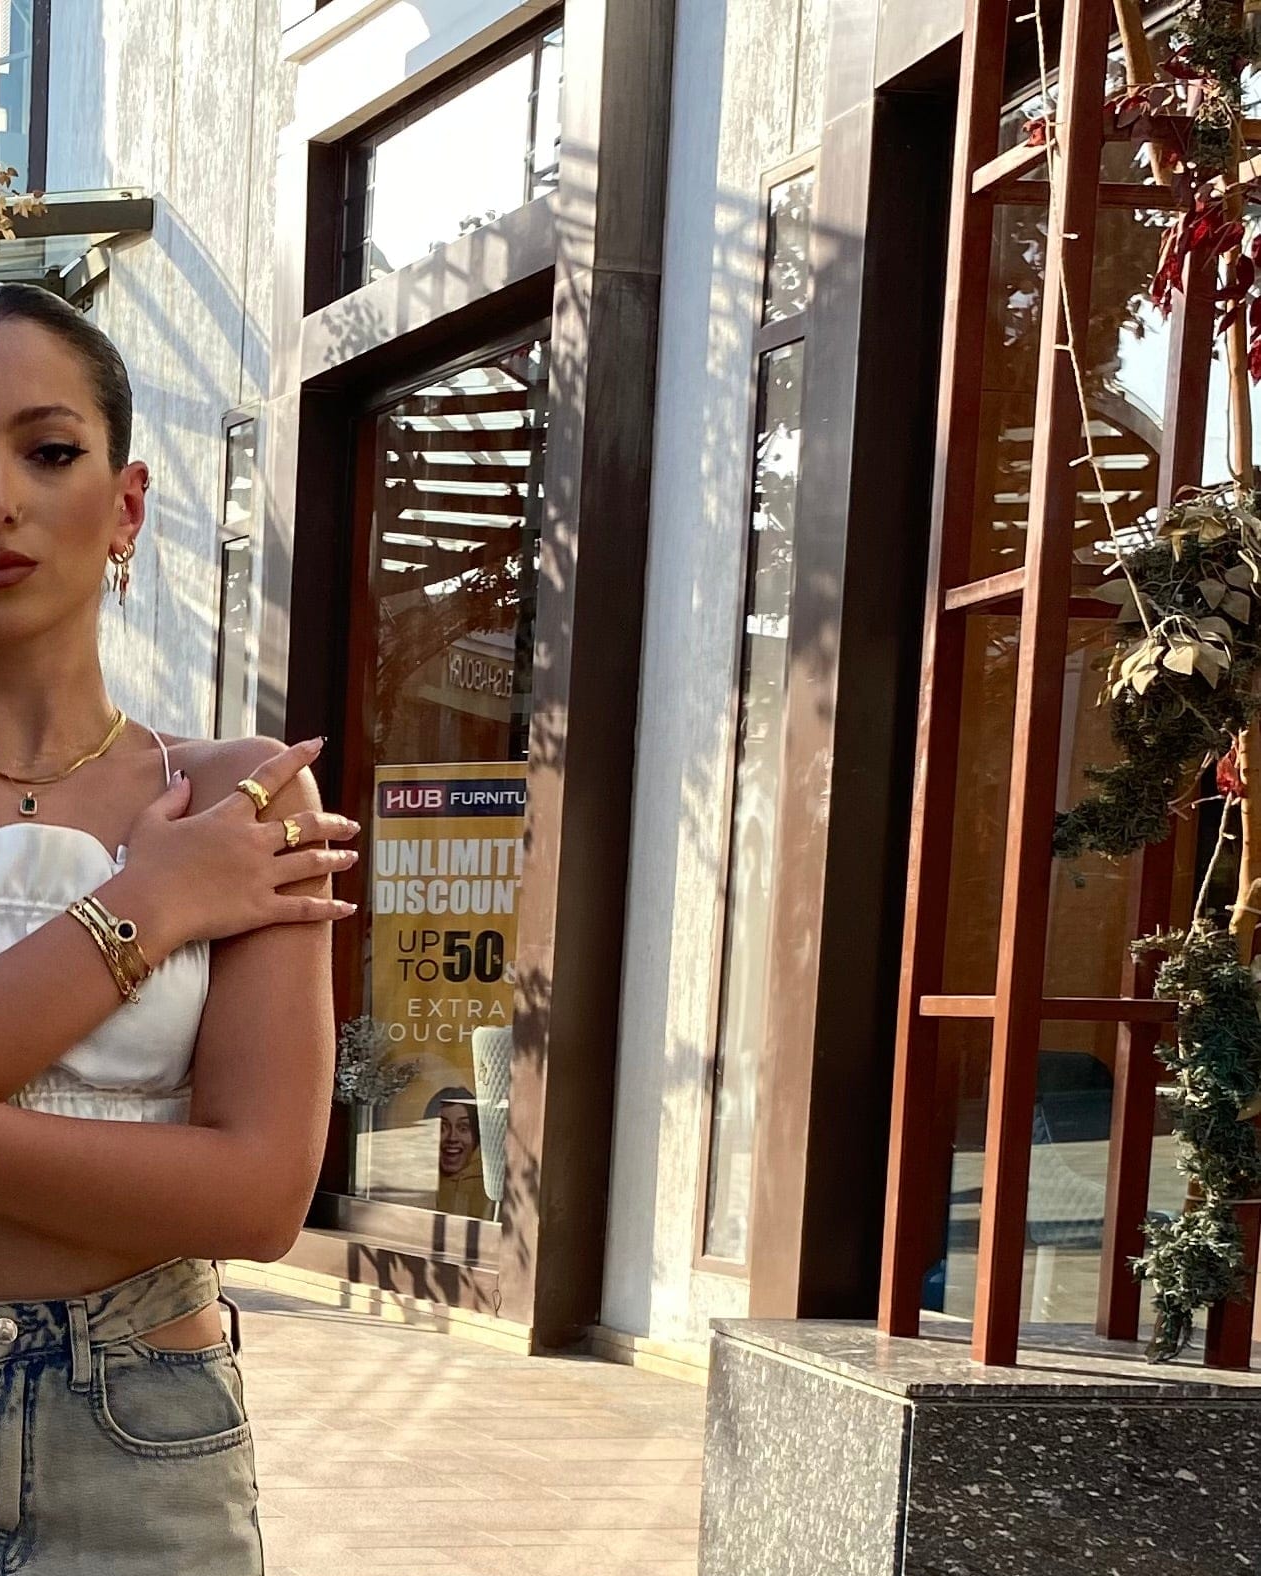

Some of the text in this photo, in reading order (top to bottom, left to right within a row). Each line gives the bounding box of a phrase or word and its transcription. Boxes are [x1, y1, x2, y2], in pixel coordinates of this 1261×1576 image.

[386, 789, 442, 809] HUB
[376, 879, 523, 915] DISCOUN
[398, 930, 440, 953] UP
[397, 959, 439, 982] TO
[408, 998, 506, 1019] EXTRA
